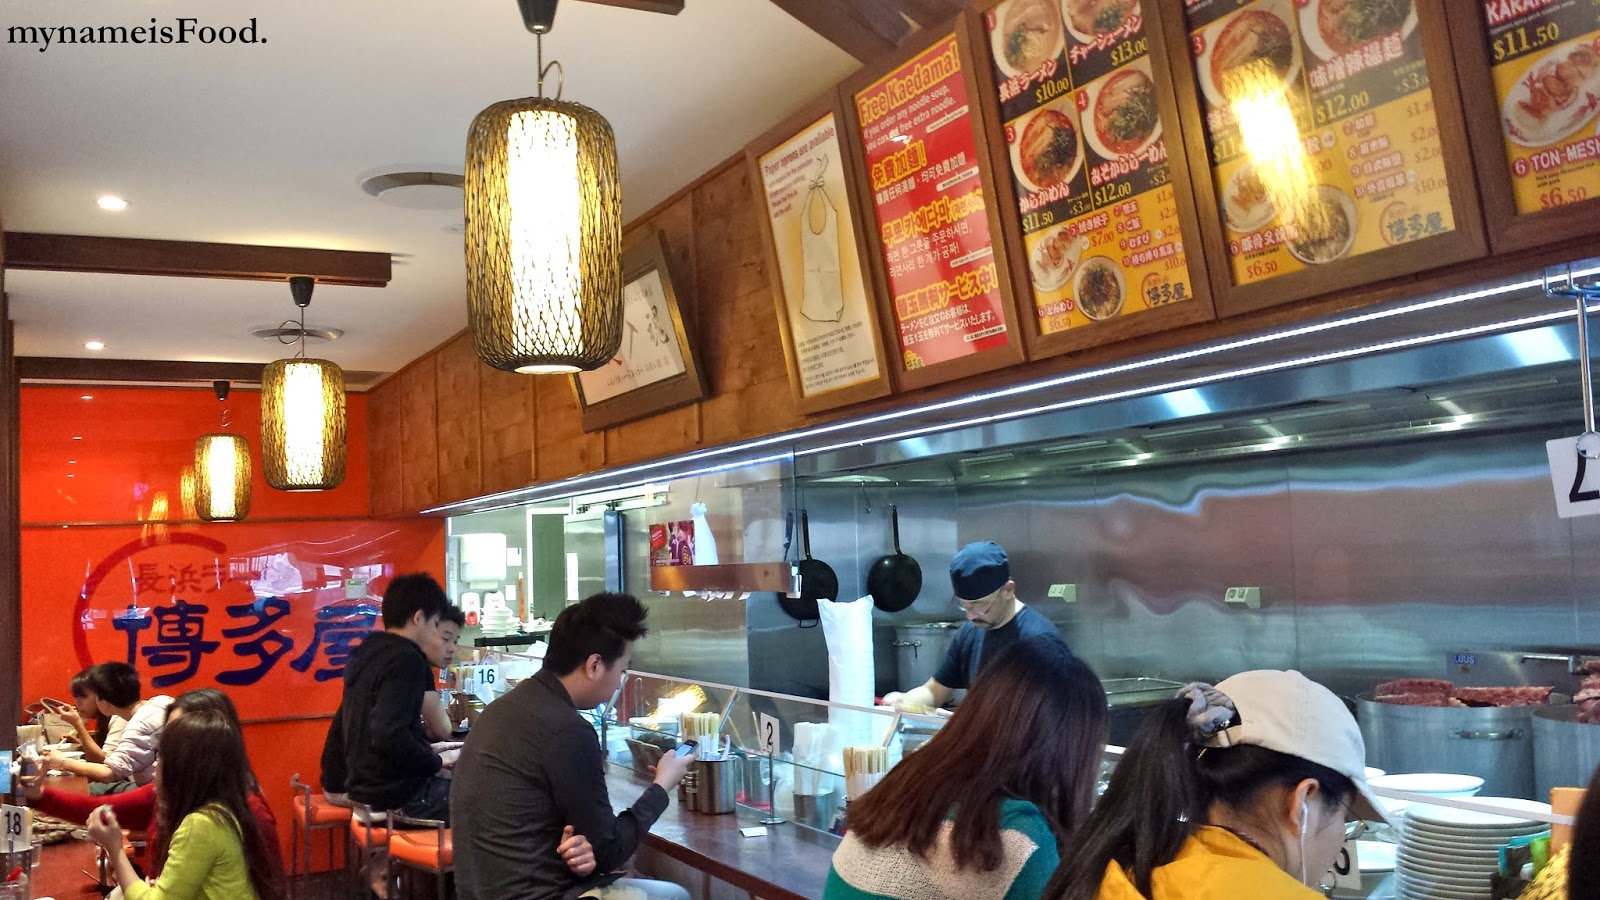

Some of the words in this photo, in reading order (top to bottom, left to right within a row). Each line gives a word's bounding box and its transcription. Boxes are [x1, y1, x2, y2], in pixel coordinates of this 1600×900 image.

[1493, 21, 1559, 60] $11.50
[857, 92, 888, 127] Free
[886, 41, 960, 109] Kaedama!
[1035, 77, 1069, 103] $10.00
[1316, 90, 1369, 124] $12.00
[880, 114, 897, 134] order
[897, 110, 908, 122] any
[1515, 159, 1526, 175] 6
[1094, 181, 1132, 207] $12.00
[1022, 211, 1054, 233] $11.50
[1387, 211, 1446, 241] 博多屋
[1247, 260, 1278, 279] $6.50
[112, 596, 385, 688] 博多屋
[478, 668, 495, 685] 16
[766, 721, 774, 746] 2
[4, 810, 21, 835] 18
